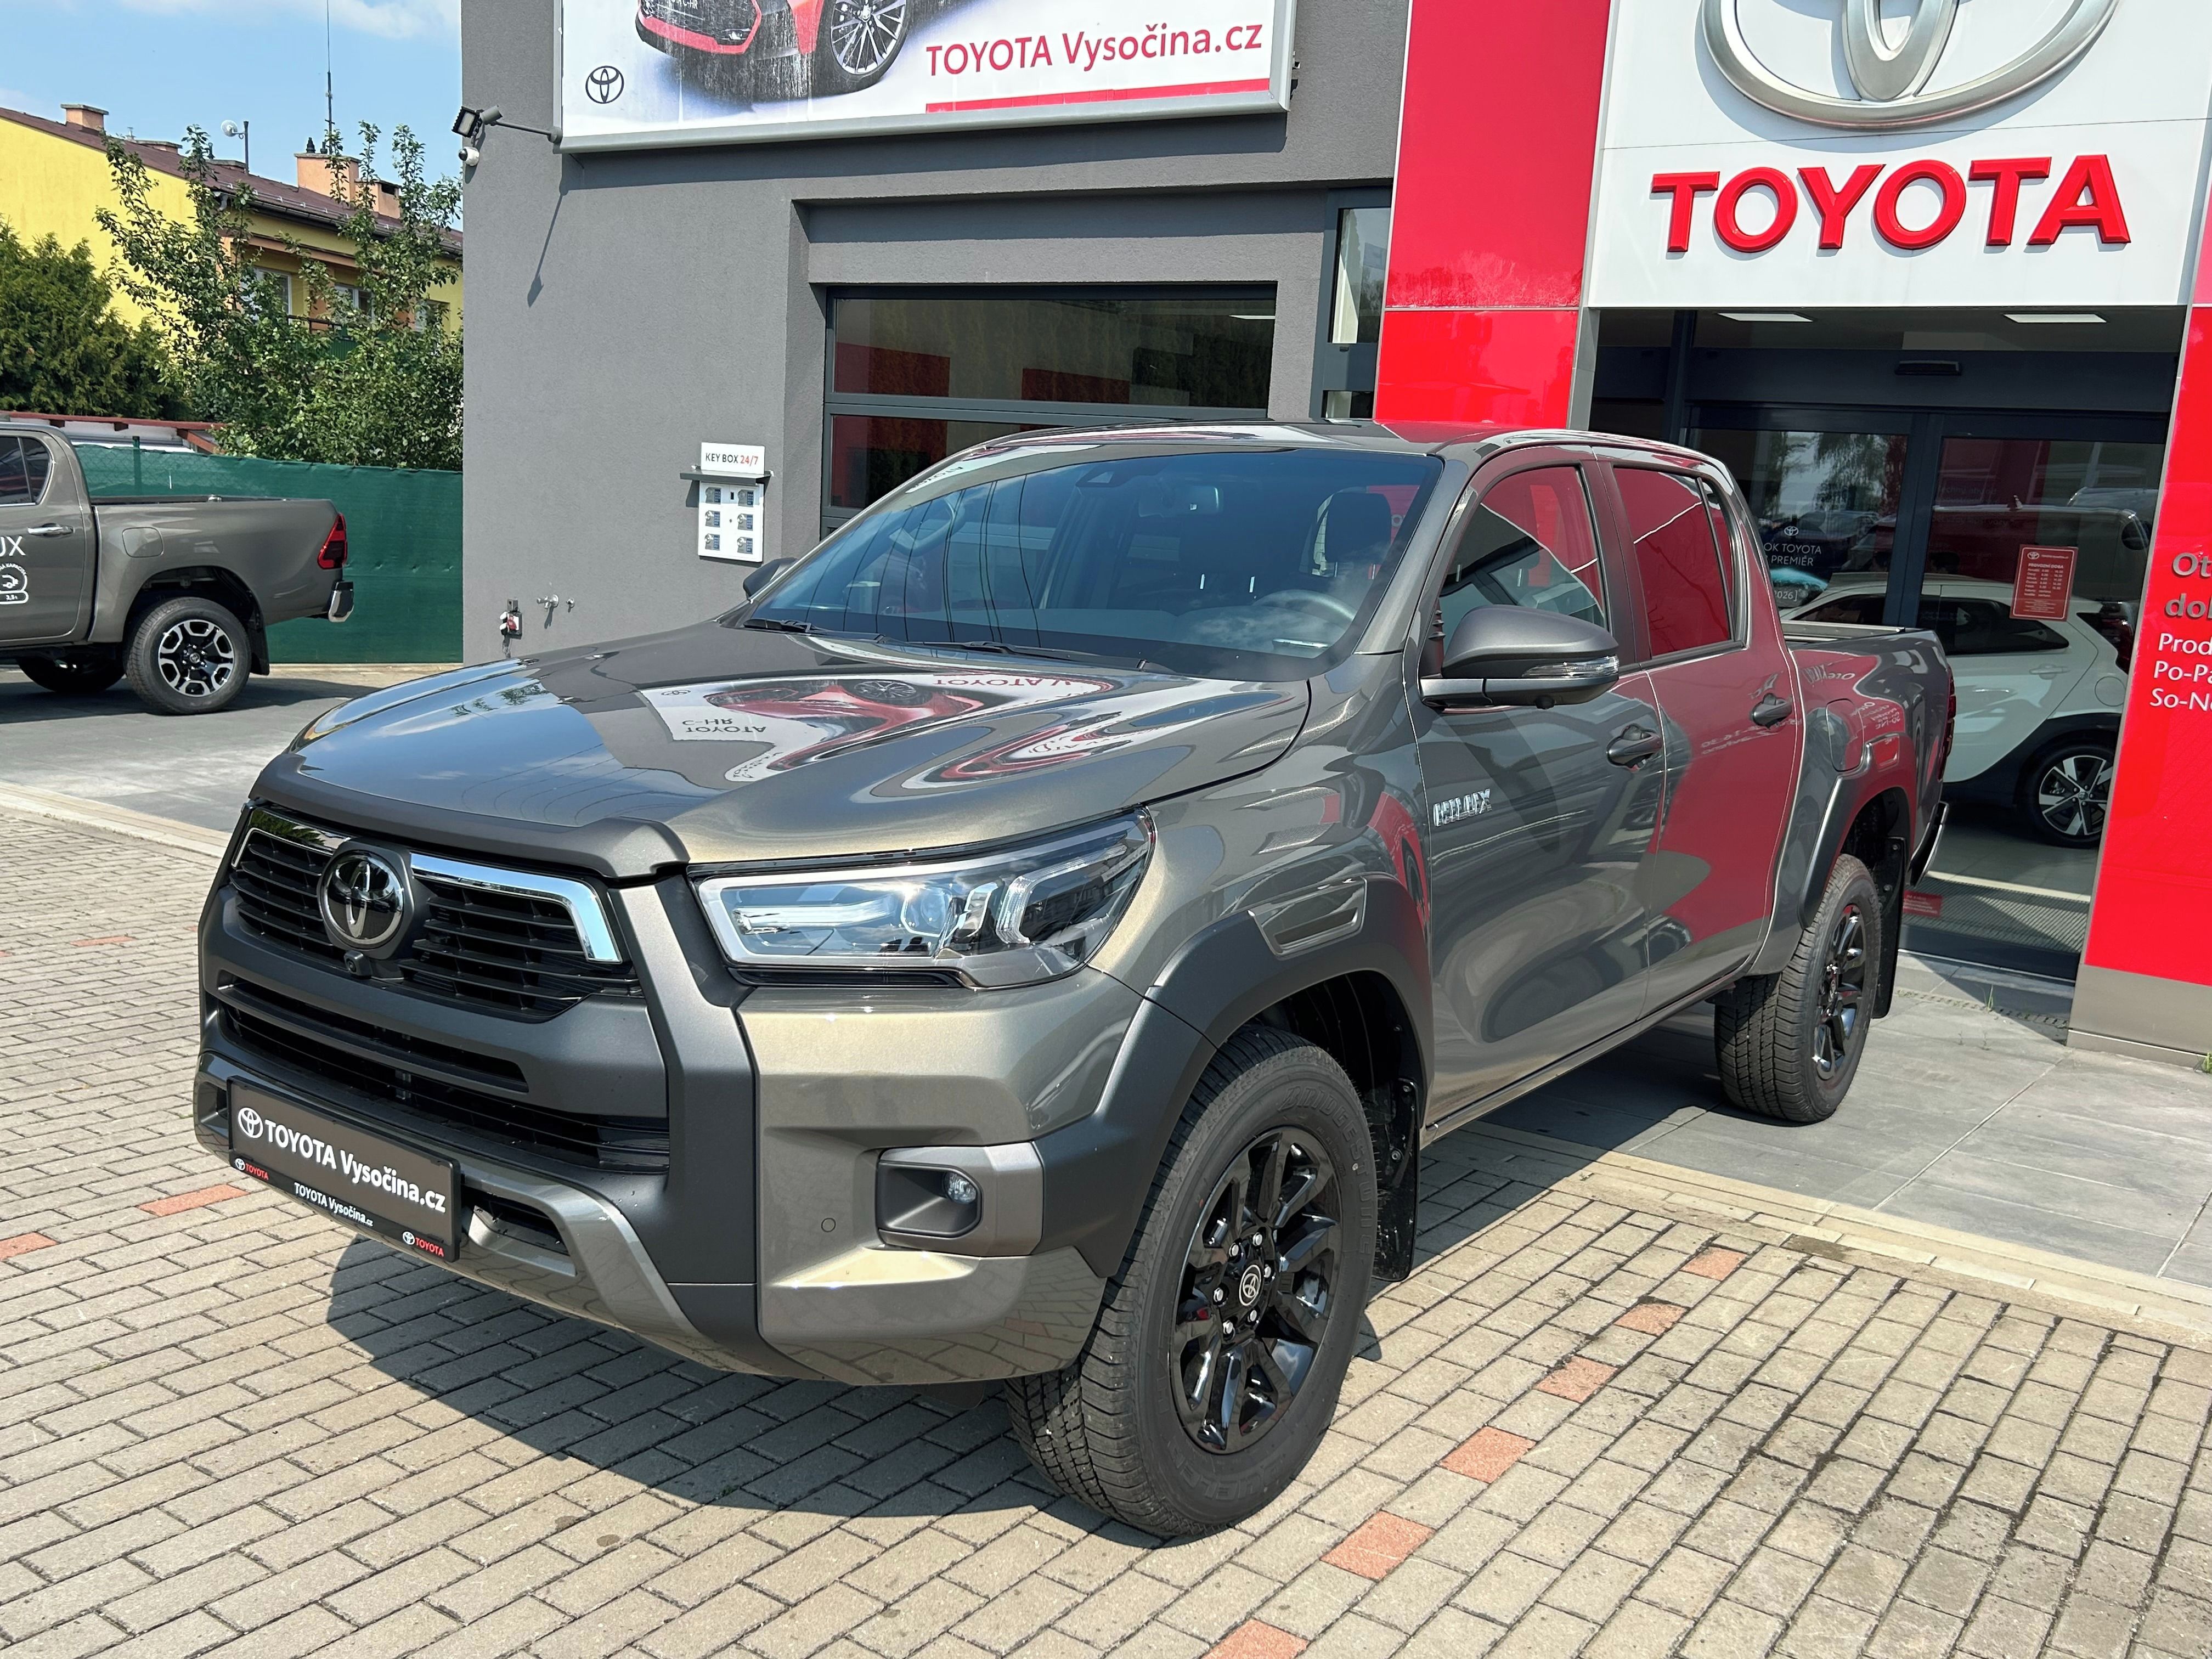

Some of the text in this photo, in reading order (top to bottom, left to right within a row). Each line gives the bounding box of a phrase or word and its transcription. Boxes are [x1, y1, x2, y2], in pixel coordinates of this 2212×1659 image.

[926, 22, 1263, 76] TOYOTA Vysočina.cz
[1651, 154, 2131, 253] TOYOTA
[706, 453, 759, 466] KEY BOX 24/7
[1763, 542, 1822, 555] OK TOYOTA
[2164, 592, 2212, 619] do
[2149, 687, 2212, 712] So-N
[1433, 788, 1492, 827] HILUX
[245, 1163, 269, 1181] TOYOTA
[264, 1119, 447, 1213] TOYOTA Vysočina.cz
[294, 1182, 374, 1227] TOYOTA Vysočina.cz
[415, 1236, 444, 1257] TOYOTA
